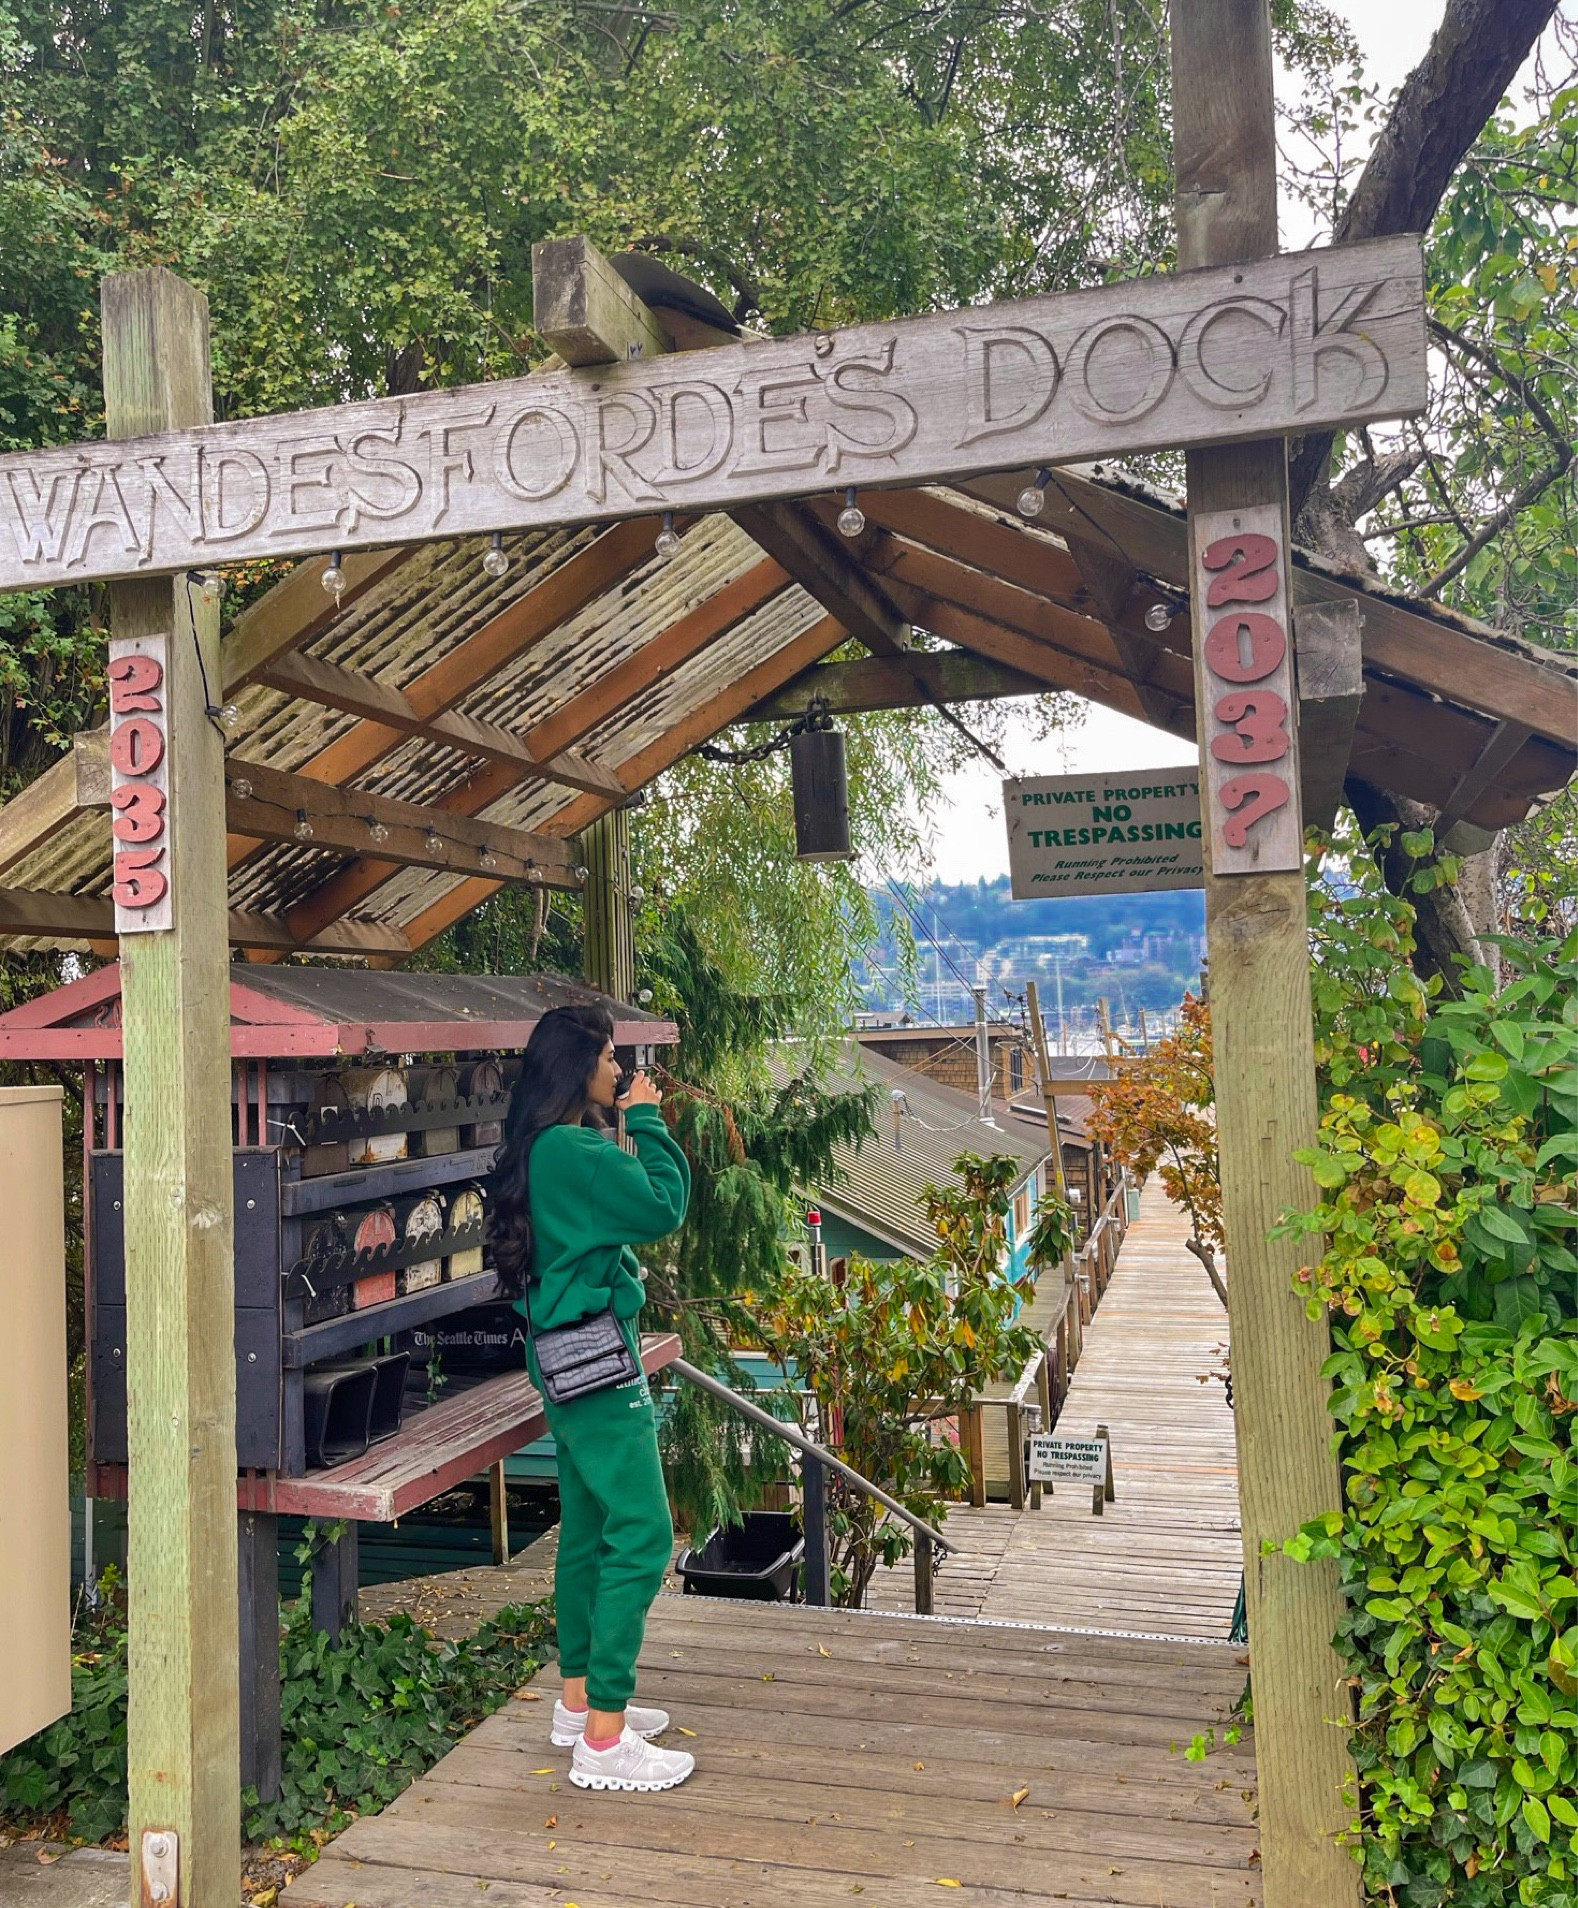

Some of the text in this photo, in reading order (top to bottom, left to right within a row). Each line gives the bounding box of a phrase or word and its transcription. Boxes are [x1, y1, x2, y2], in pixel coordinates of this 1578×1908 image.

[2, 265, 1390, 567] WANDESFORDE'S DOCK
[106, 655, 168, 907] 2035
[1022, 783, 1199, 806] PRIVATE PROPERTY
[1092, 804, 1132, 823] NO
[1027, 820, 1202, 848] TRESPASSING
[1054, 853, 1179, 870] Running Prohibited
[1030, 873, 1071, 883] Please
[1074, 869, 1125, 881] Respect
[1129, 868, 1154, 877] our
[437, 1331, 473, 1345] Seattle
[473, 1330, 508, 1346] Times
[1033, 1440, 1103, 1452] PRIVATE PROPERTY
[1037, 1450, 1099, 1462] NO TRESPASSING
